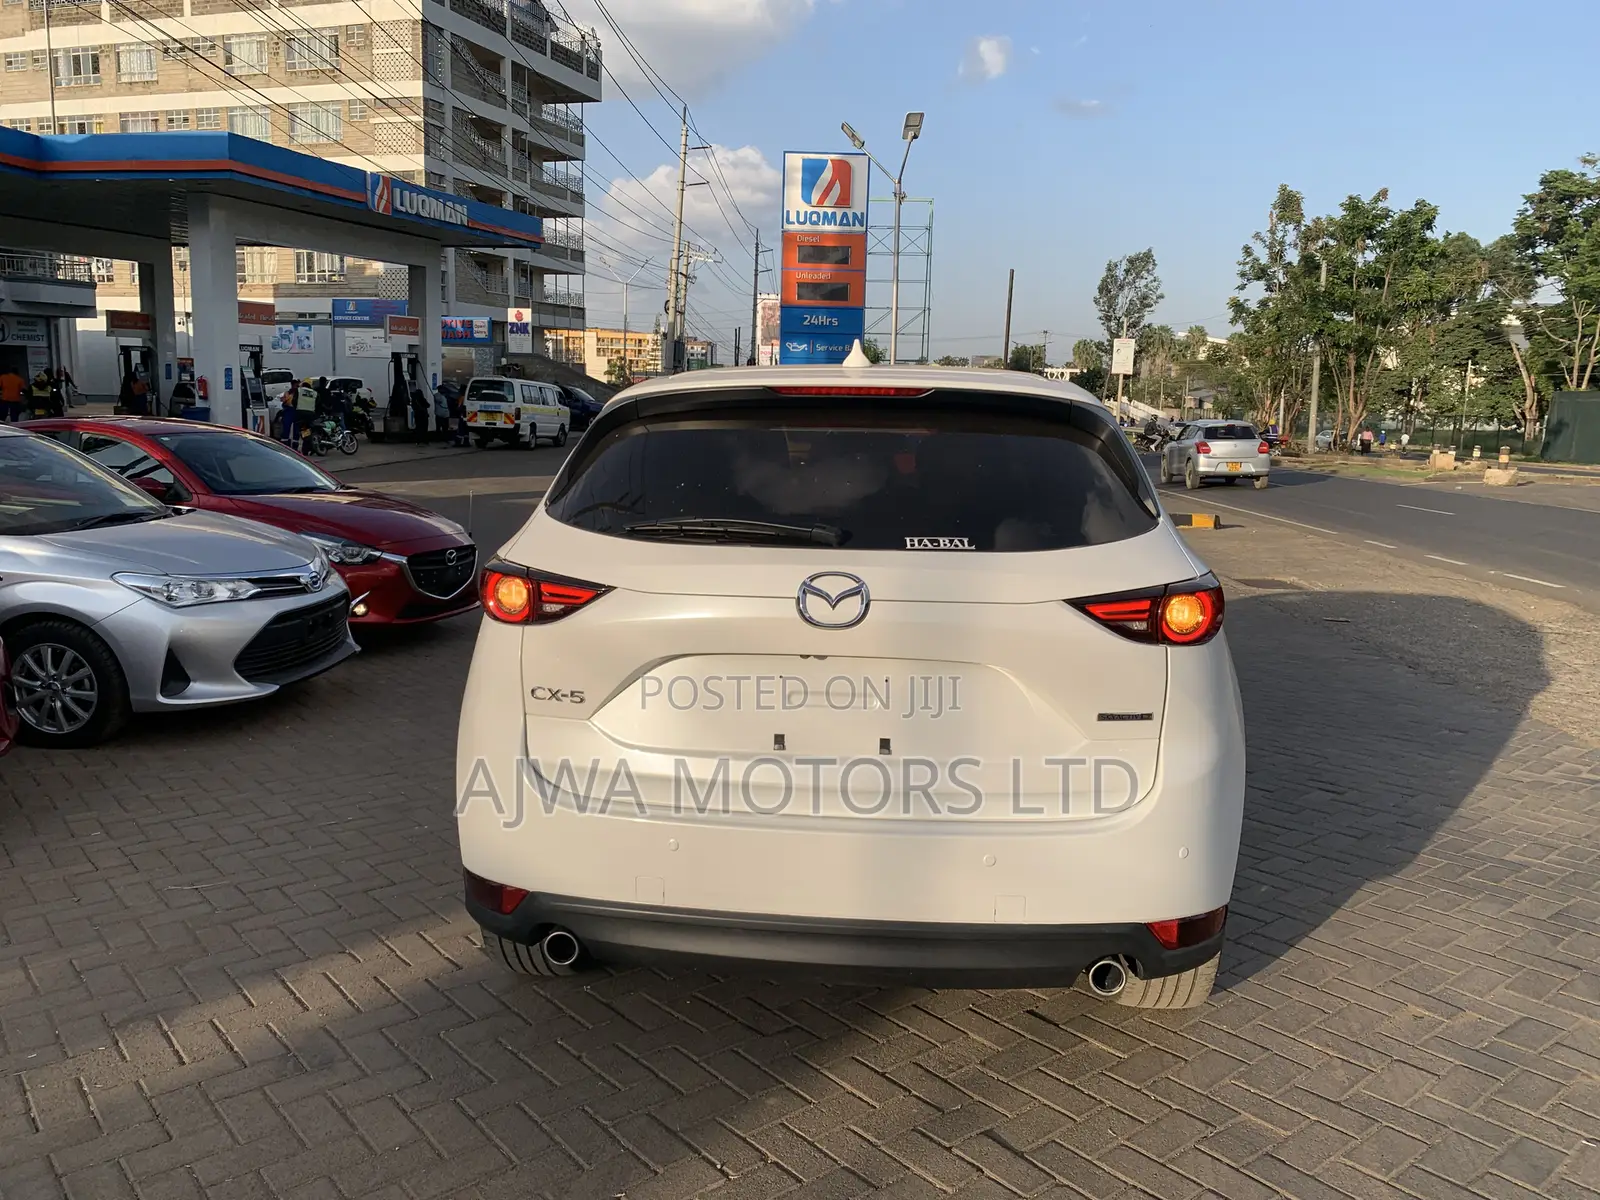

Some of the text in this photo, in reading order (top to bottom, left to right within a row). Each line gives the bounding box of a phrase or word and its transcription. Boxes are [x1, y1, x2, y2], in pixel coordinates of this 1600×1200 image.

[392, 187, 469, 226] LUQMAN
[785, 210, 865, 227] LUQMAN
[797, 235, 820, 243] Diesel
[796, 271, 831, 280] Unleaded
[803, 315, 839, 327] 24Hrs
[509, 322, 530, 334] ZNK
[11, 333, 45, 342] CHEMIST
[816, 343, 844, 352] Service
[905, 537, 976, 550] HA-BAL
[530, 686, 586, 704] CX-5
